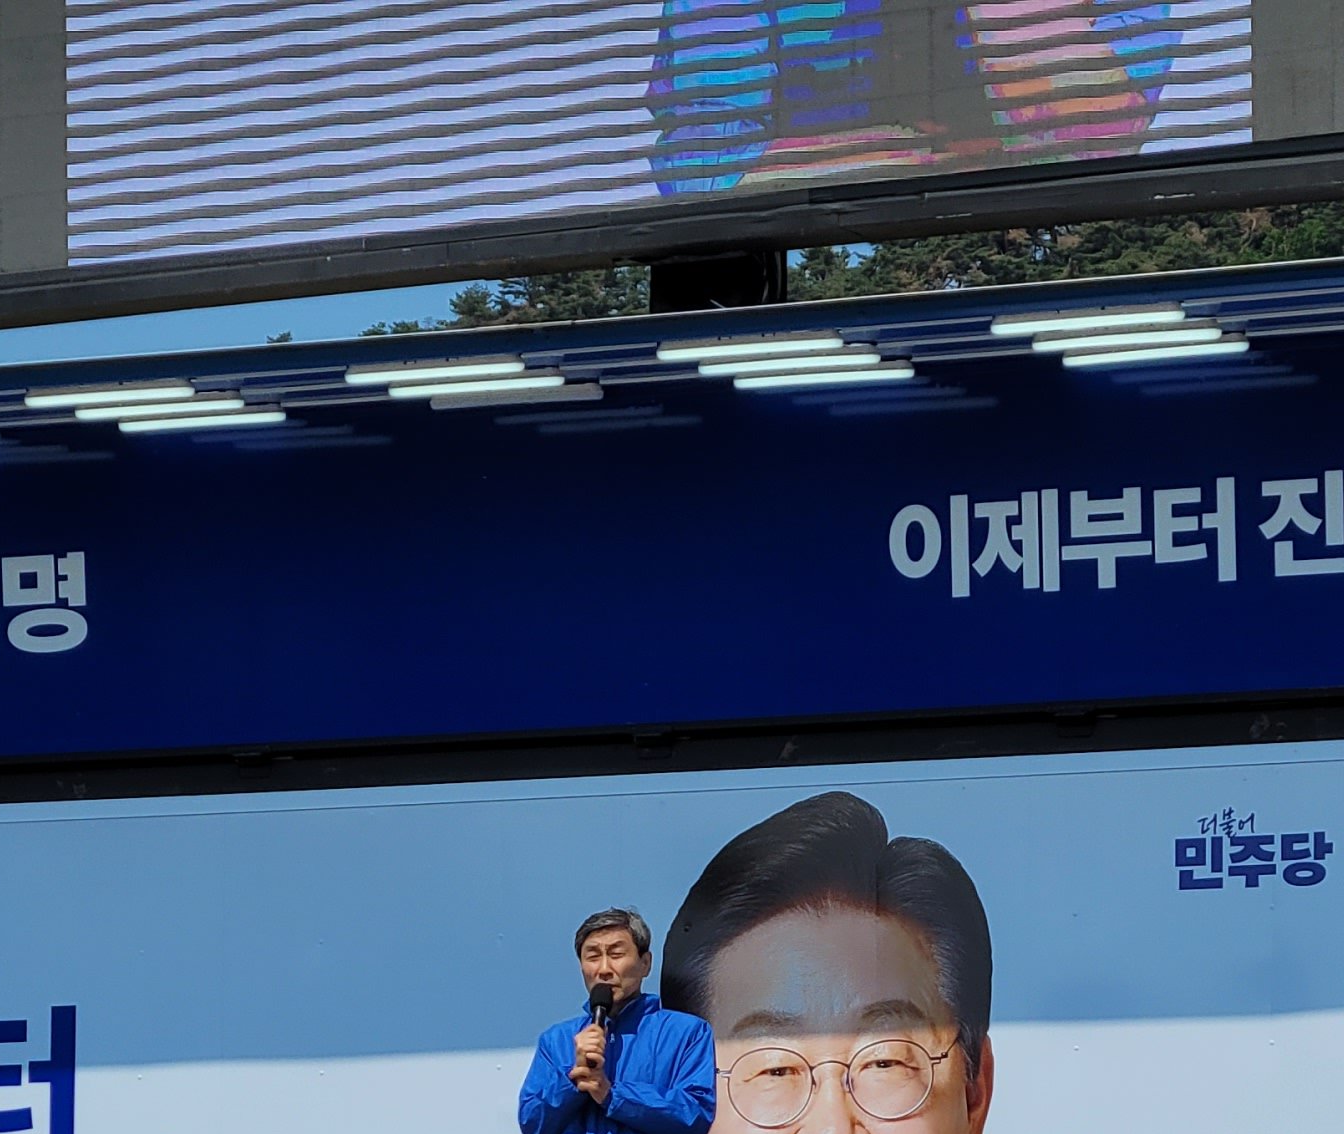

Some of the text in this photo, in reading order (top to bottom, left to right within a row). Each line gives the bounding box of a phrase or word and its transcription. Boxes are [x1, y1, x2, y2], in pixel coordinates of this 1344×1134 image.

[888, 475, 1238, 598] 이제부터
[1197, 806, 1256, 838] 더불어
[1174, 831, 1334, 891] 민주당
